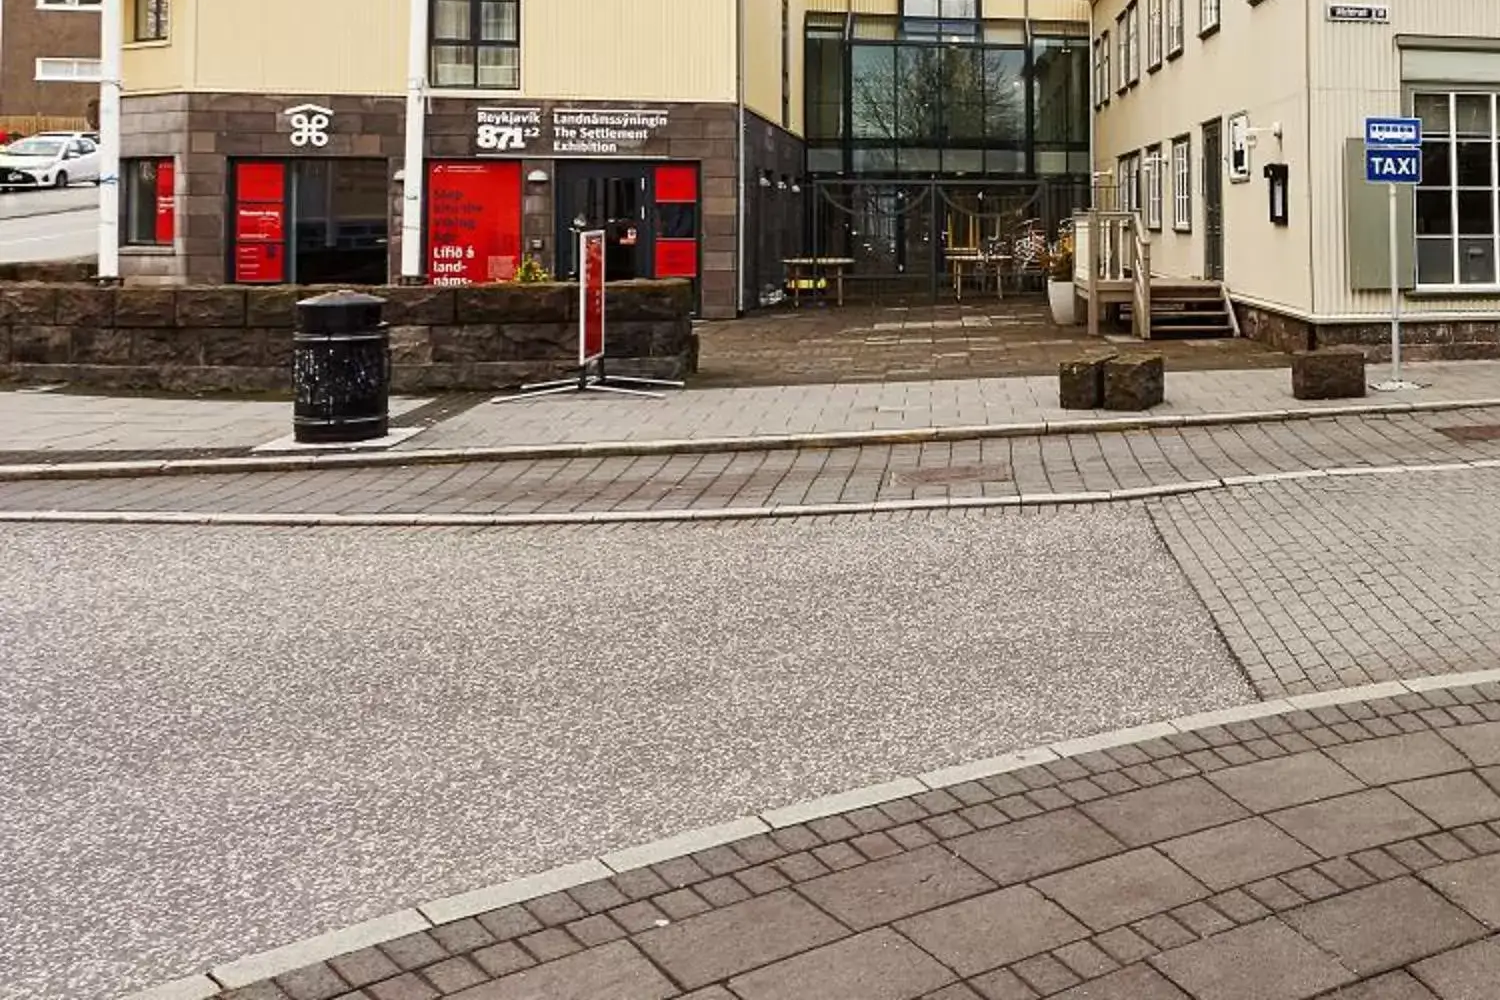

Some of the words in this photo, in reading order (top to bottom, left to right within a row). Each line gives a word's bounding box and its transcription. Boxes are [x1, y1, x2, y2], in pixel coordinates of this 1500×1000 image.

[553, 113, 668, 127] Landnámssýningin
[554, 127, 577, 139] The
[579, 127, 648, 140] Settlement
[553, 139, 617, 152] Exhibition
[1371, 157, 1416, 175] TAXI
[466, 245, 475, 259] á
[433, 260, 468, 273] land-
